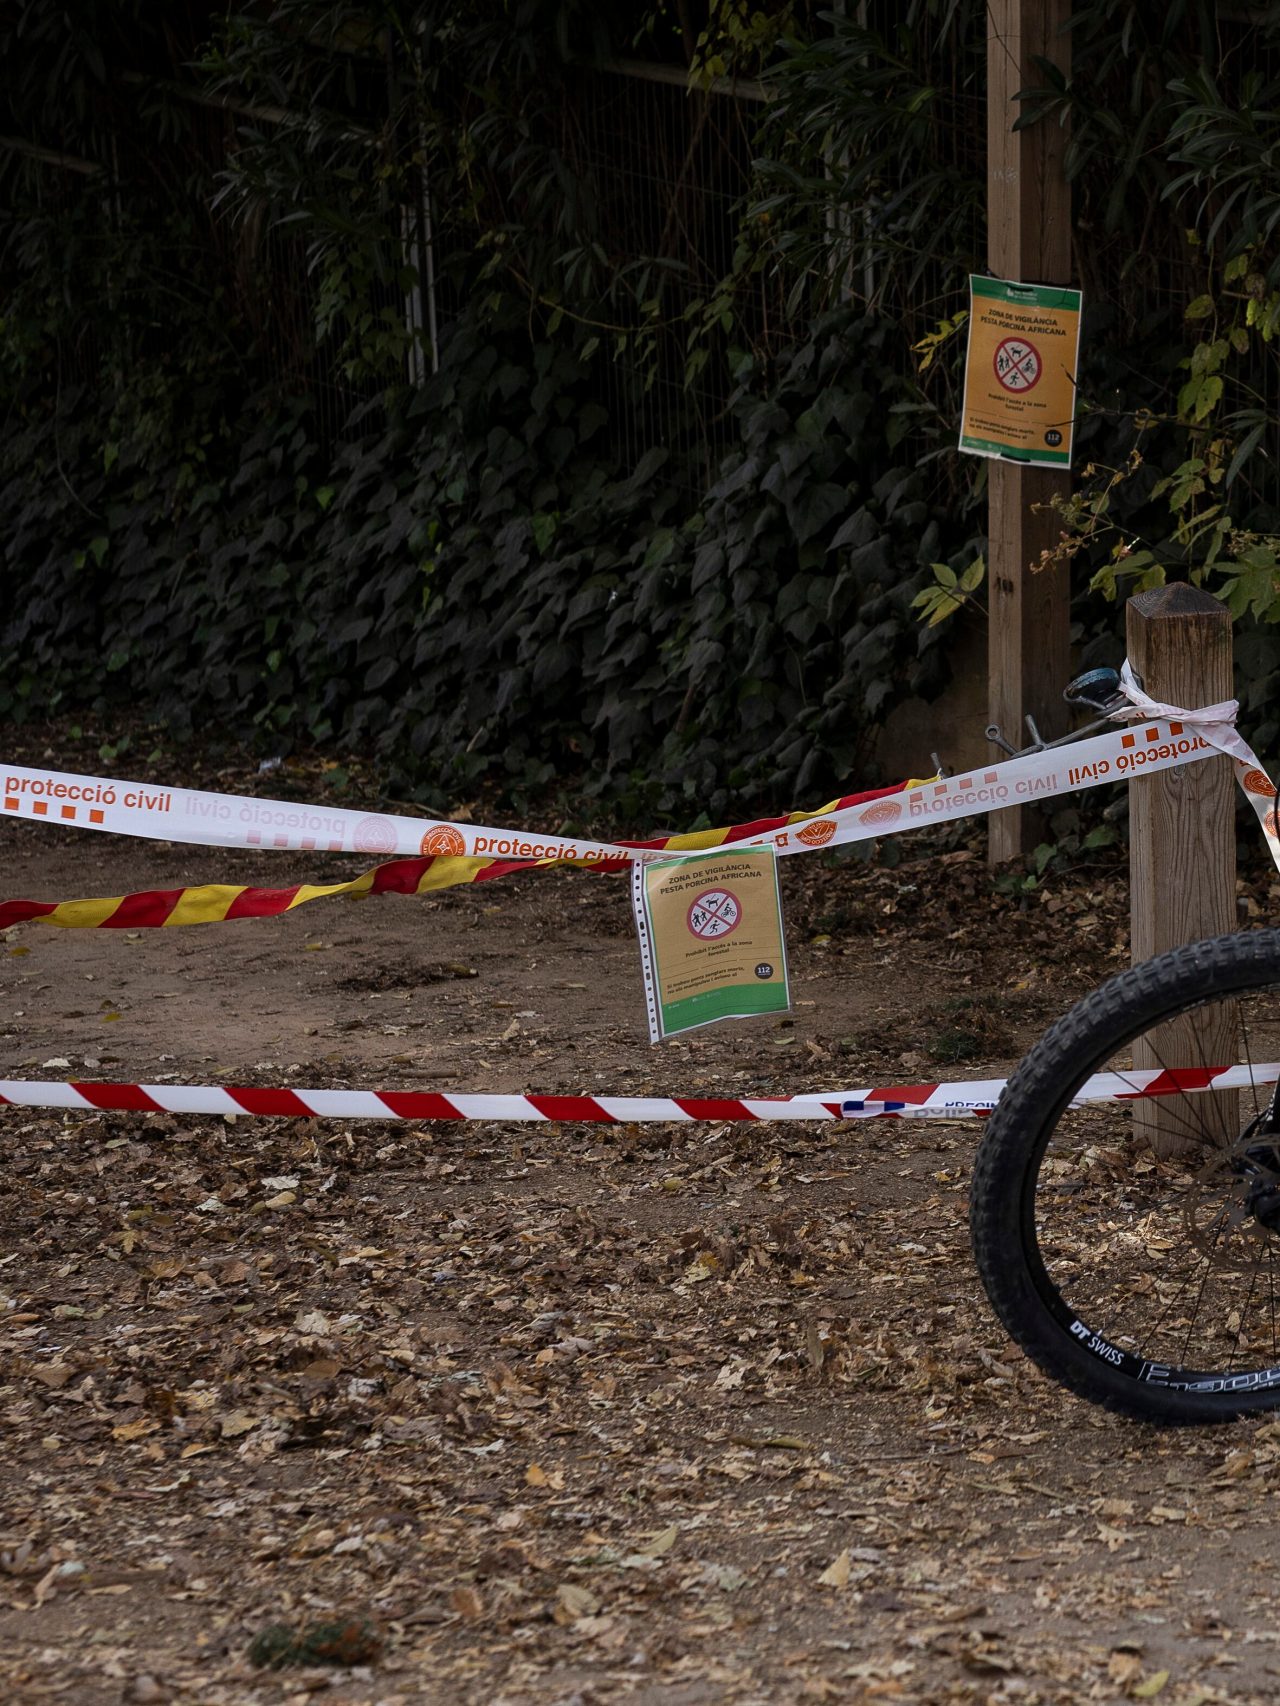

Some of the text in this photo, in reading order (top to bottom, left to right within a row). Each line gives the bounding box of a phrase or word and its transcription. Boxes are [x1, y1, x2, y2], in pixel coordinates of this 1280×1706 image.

[988, 309, 1004, 319] ZONA
[1005, 313, 1013, 321] DE
[980, 316, 1066, 336] PESTA PORCINA AFRICANA
[1047, 432, 1060, 440] 112
[1068, 762, 1110, 786] civil
[5, 776, 171, 812] protecció civil
[473, 836, 577, 859] protecció
[660, 871, 762, 895] PESTA PORCINA AFRICANA
[669, 874, 691, 884] ZONA
[692, 870, 703, 879] DE
[758, 966, 771, 974] 112
[1070, 1319, 1125, 1366] DT SWISS
